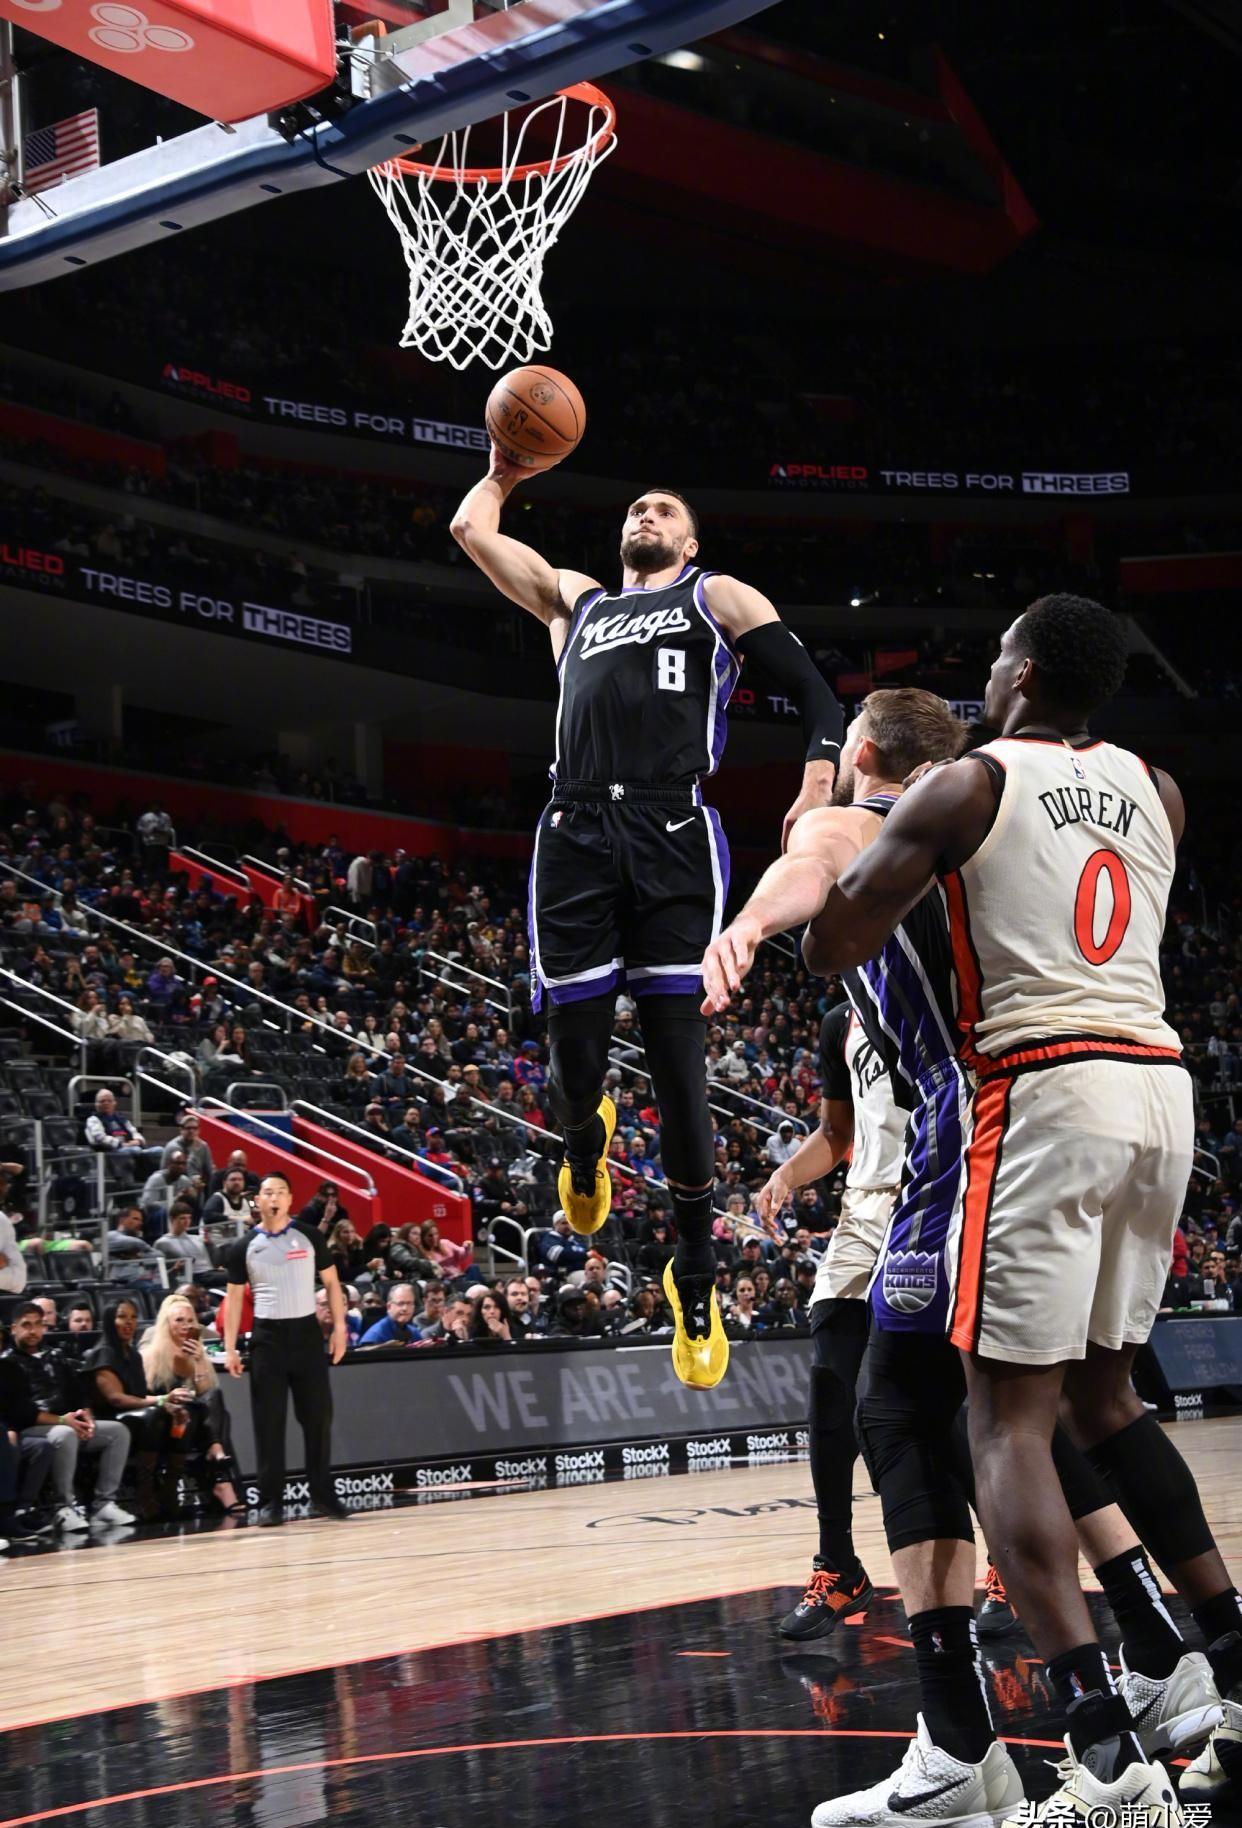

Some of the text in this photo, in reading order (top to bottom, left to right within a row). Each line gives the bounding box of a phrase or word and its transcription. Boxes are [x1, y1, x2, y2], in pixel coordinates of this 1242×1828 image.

[161, 362, 254, 404] APPLIED
[263, 396, 347, 427] TREES
[353, 411, 405, 436] FOR
[414, 420, 491, 450] THRE
[769, 463, 868, 480] APPLIED
[880, 470, 1128, 492] TREES FOR THREES
[0, 544, 64, 575] LIED
[80, 568, 351, 652] TREES FOR THREES
[579, 607, 691, 660] Kings
[658, 648, 686, 692] 8
[1038, 787, 1136, 837] DUREN
[1074, 849, 1131, 966] 0
[886, 1275, 935, 1288] KINGS
[447, 1370, 549, 1432] WE
[559, 1363, 662, 1425] ARE
[1174, 1393, 1203, 1407] StockX
[686, 1438, 731, 1457] StockX
[747, 1432, 790, 1451] StockX
[555, 1451, 605, 1471] StockX
[622, 1444, 669, 1464] StockX
[416, 1465, 472, 1487] StockX
[495, 1457, 547, 1477] StockX
[334, 1473, 394, 1495] StockX
